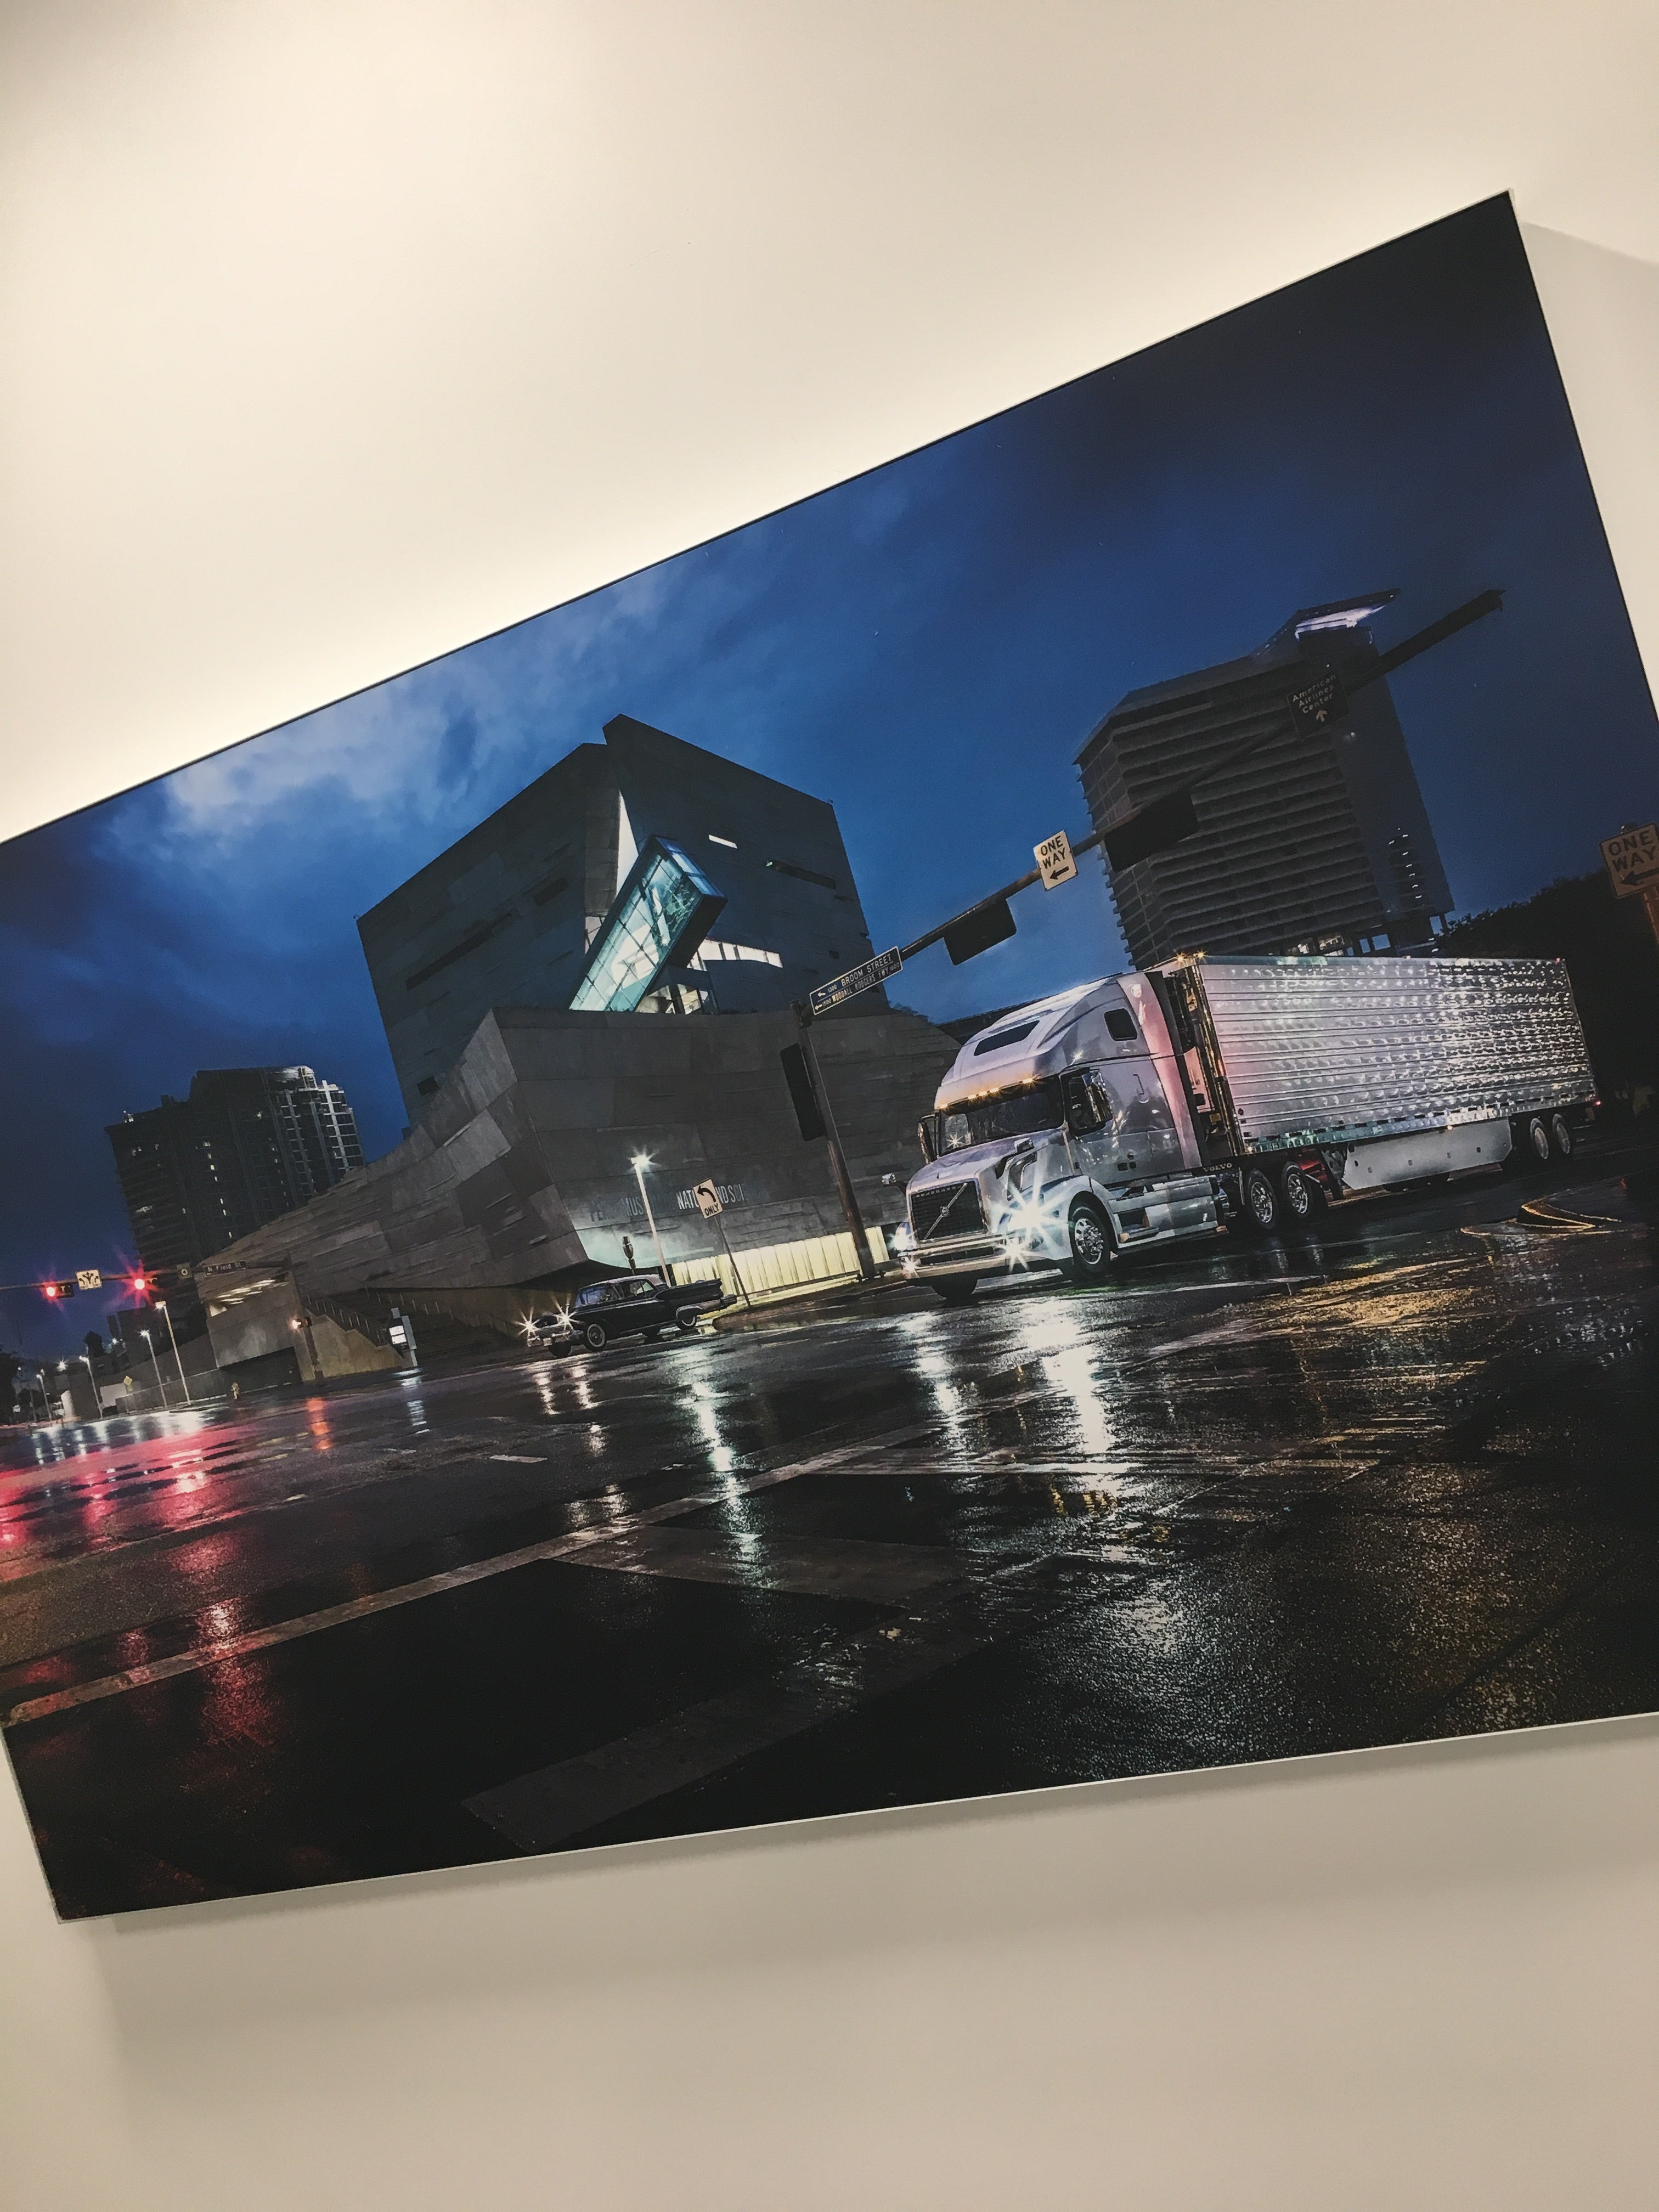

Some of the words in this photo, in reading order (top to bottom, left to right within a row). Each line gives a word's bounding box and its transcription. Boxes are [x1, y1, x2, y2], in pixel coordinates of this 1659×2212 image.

[1293, 674, 1337, 703] American
[1299, 684, 1335, 708] Airlines
[1302, 693, 1334, 714] Center
[1040, 835, 1064, 856] ONE
[1609, 830, 1654, 856] ONE
[1042, 847, 1065, 870] WAY
[1611, 845, 1656, 873] WAY
[841, 968, 864, 987] BROOM
[867, 953, 892, 973] STREET
[832, 987, 853, 1003] WOODALL
[855, 973, 876, 991] RODGERS
[1202, 1163, 1232, 1172] VOLVO
[704, 1203, 719, 1216] ONLY
